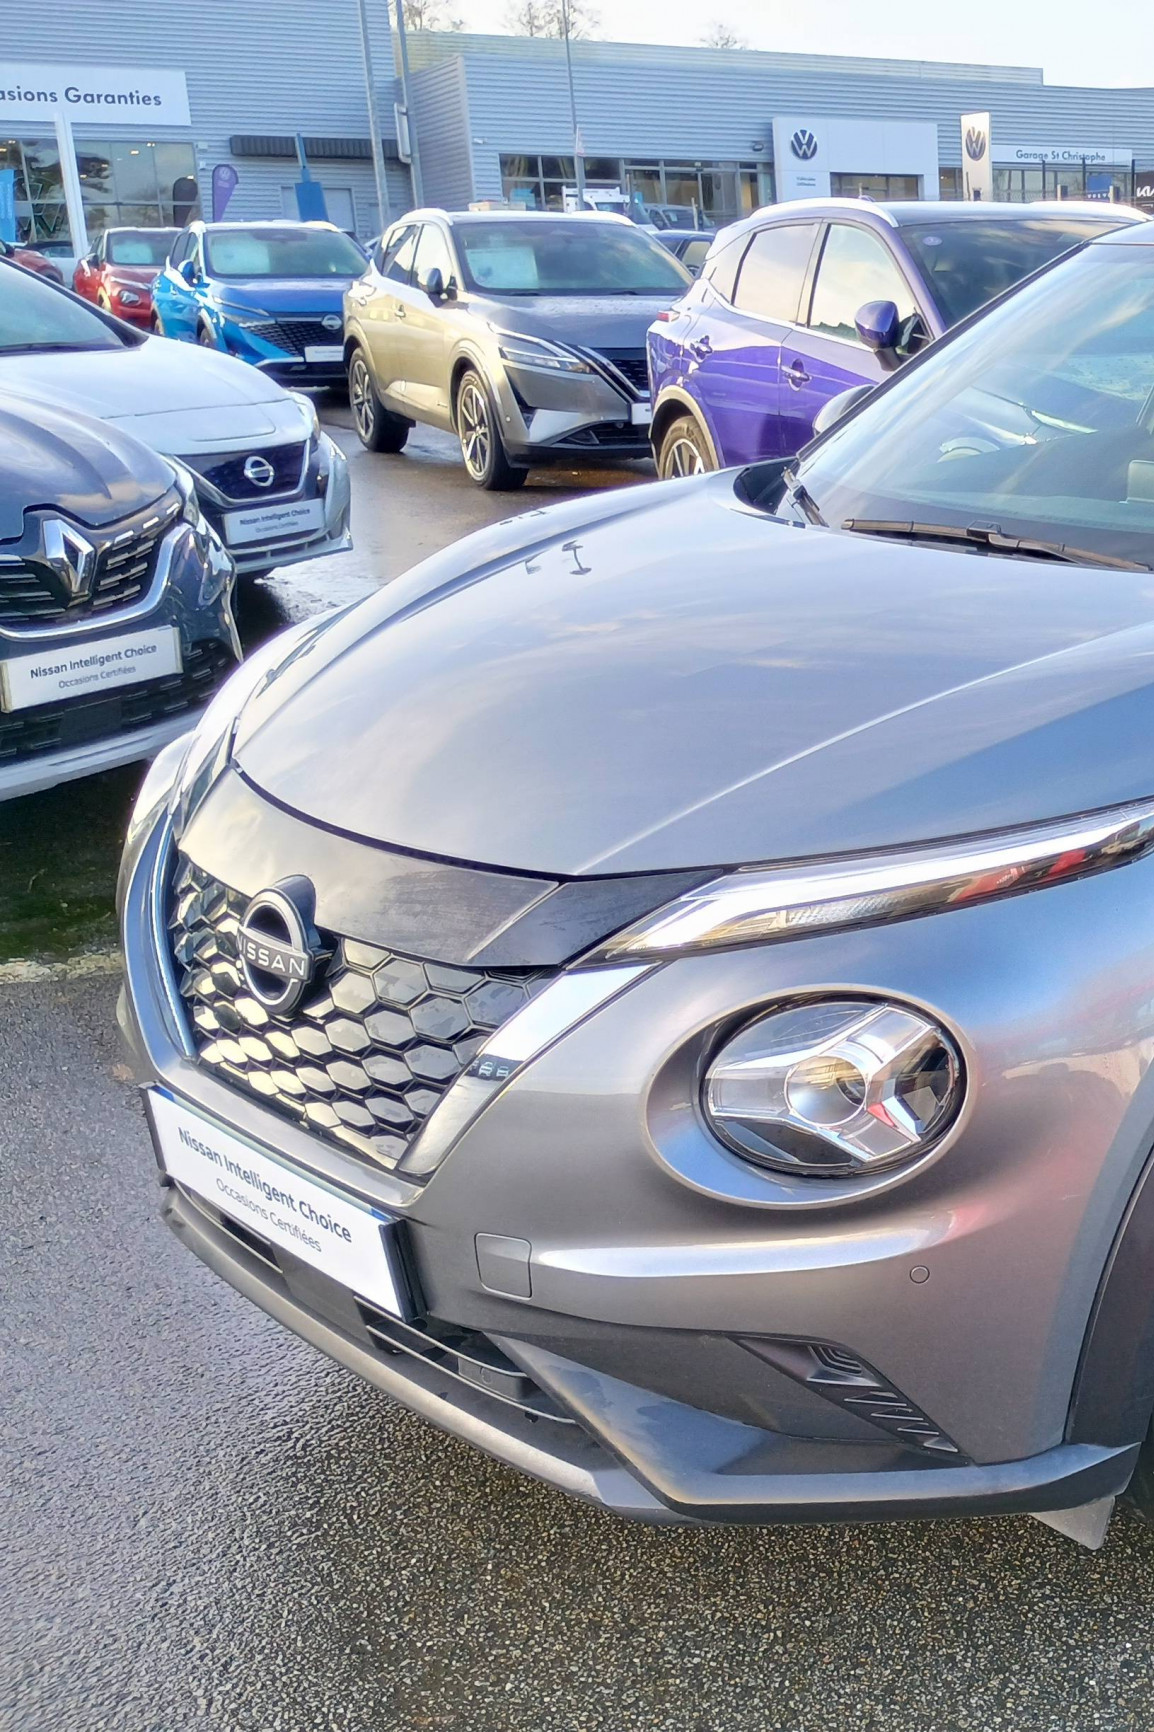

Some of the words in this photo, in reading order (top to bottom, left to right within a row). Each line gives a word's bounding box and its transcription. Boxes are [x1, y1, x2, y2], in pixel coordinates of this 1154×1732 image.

[64, 86, 162, 106] Garanties
[1016, 150, 1048, 161] Garage
[1051, 151, 1059, 160] St
[1062, 151, 1105, 163] Christophe
[30, 663, 68, 679] Nissan
[69, 650, 122, 671] Intelligent
[124, 644, 157, 658] Choice
[58, 673, 99, 689] Occasions
[100, 665, 137, 679] Certifiées
[238, 934, 305, 976] NISSAN
[178, 1126, 223, 1168] Nissan
[223, 1154, 297, 1213] Intelligent
[299, 1200, 353, 1244] Choice
[216, 1177, 269, 1221] Occasions
[270, 1211, 323, 1253] Certifiées
